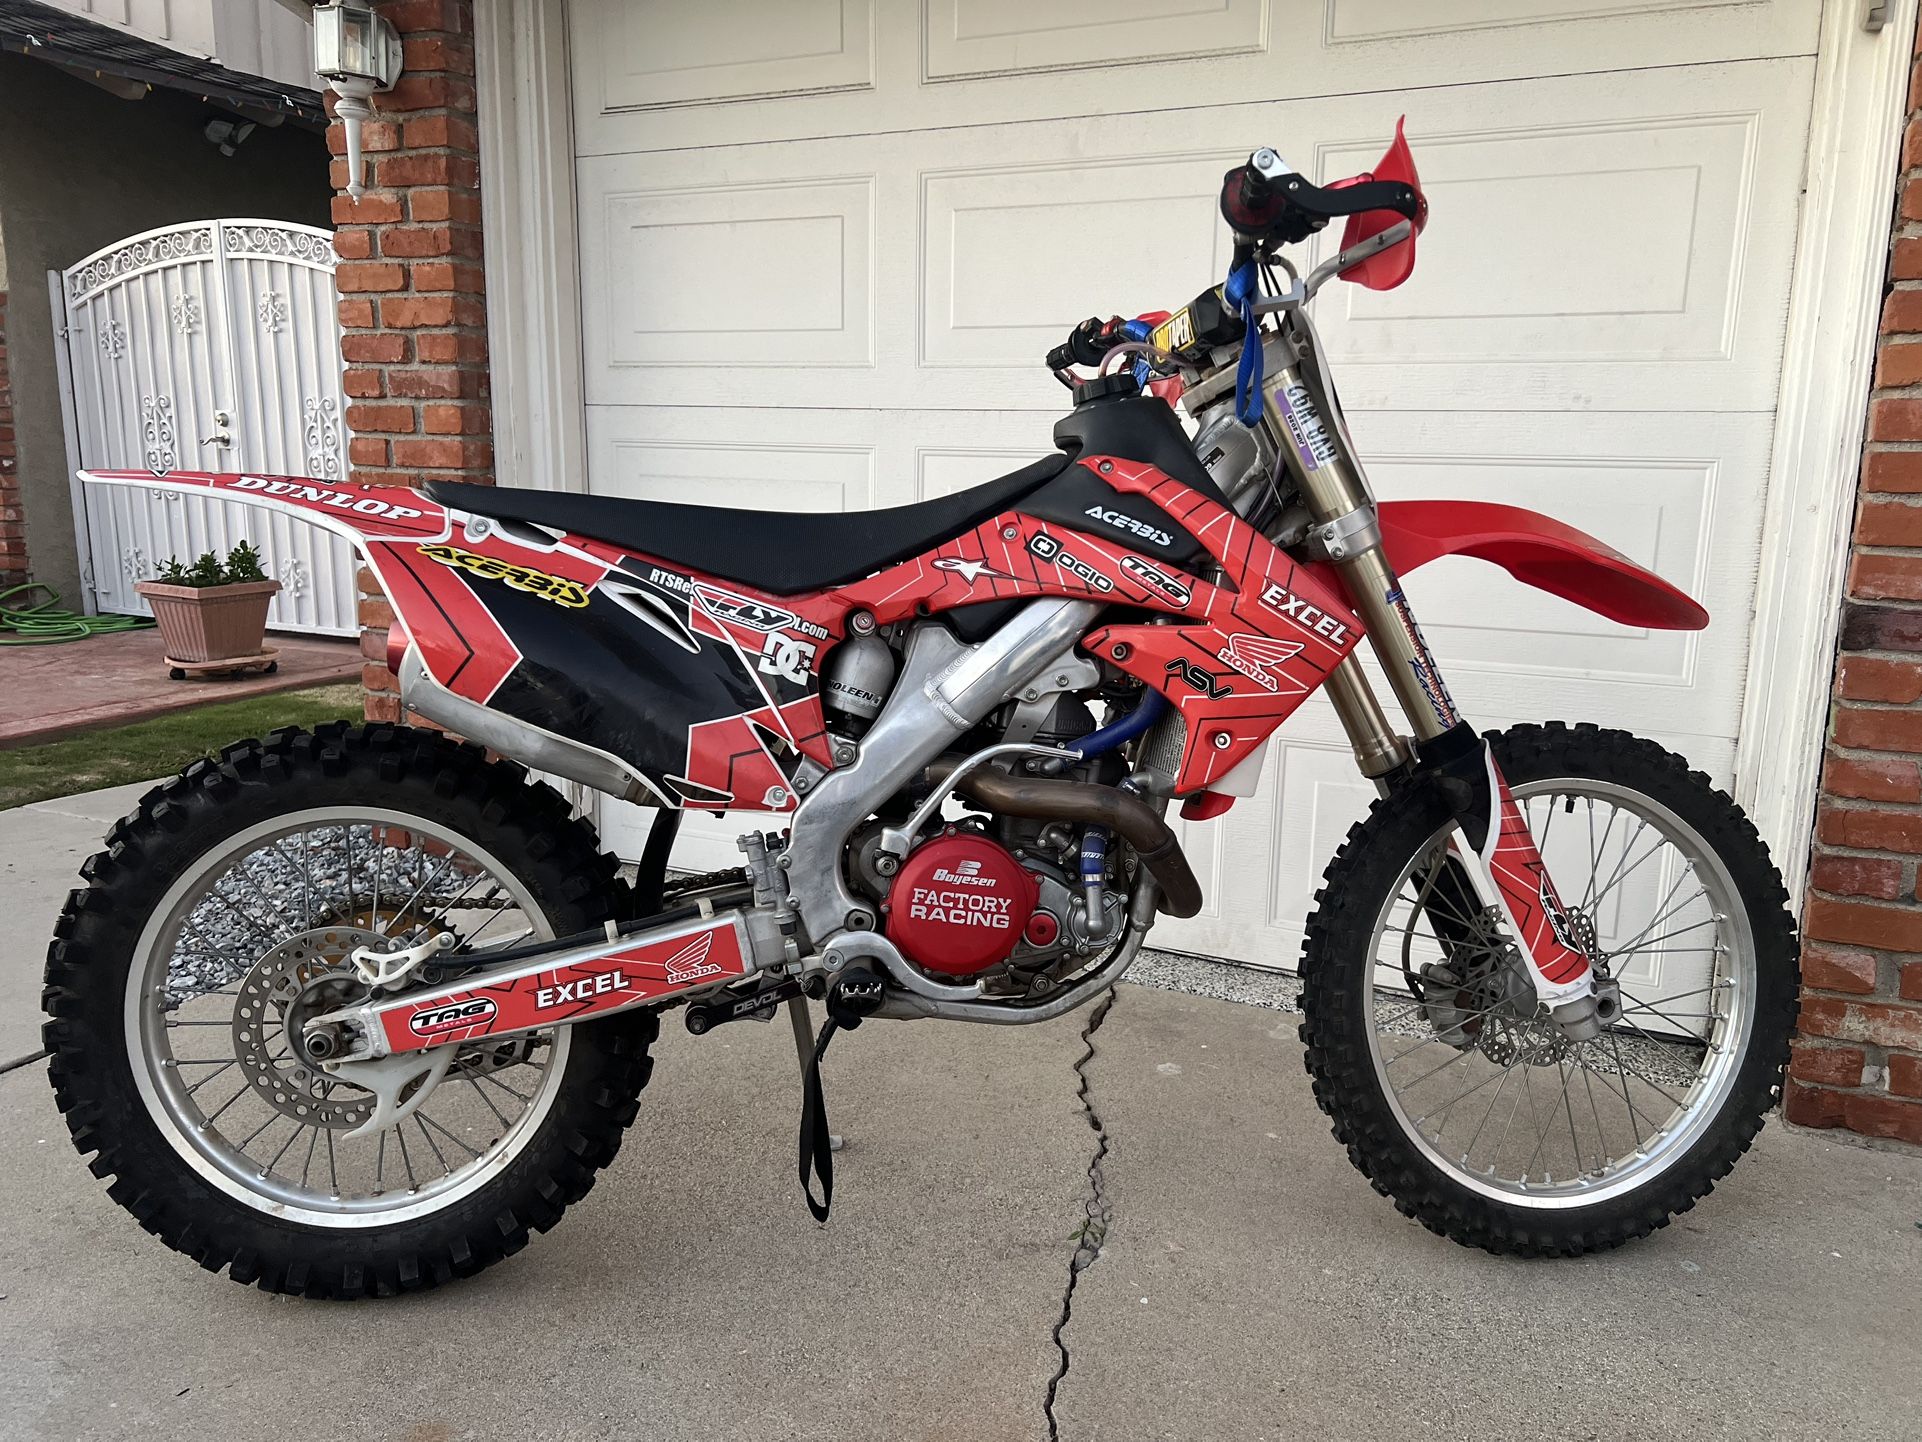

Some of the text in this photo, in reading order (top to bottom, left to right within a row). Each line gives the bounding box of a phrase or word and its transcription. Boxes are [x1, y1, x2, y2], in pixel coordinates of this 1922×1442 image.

[226, 476, 422, 520] DUNLOP
[1085, 506, 1172, 546] ACERBIS
[417, 546, 586, 604] ACERBIS
[650, 568, 692, 595] RTSRe
[1058, 553, 1114, 592] OGIO
[1123, 557, 1189, 599] TAG
[1136, 576, 1166, 597] METALS
[1261, 583, 1351, 646] EXCEL
[1395, 602, 1424, 658] SUSPENSION
[758, 631, 817, 686] DC
[1218, 648, 1279, 692] HONDA
[1165, 658, 1232, 700] ASV
[1408, 656, 1451, 730] Racing
[932, 868, 997, 887] Boyesen
[910, 904, 1010, 929] RACING
[912, 888, 1012, 914] FACTORY
[536, 971, 629, 1008] EXCEL
[667, 963, 722, 984] HONDA
[413, 1000, 489, 1027] TAG
[733, 990, 783, 1015] DEVOL
[436, 1017, 473, 1030] METALS
